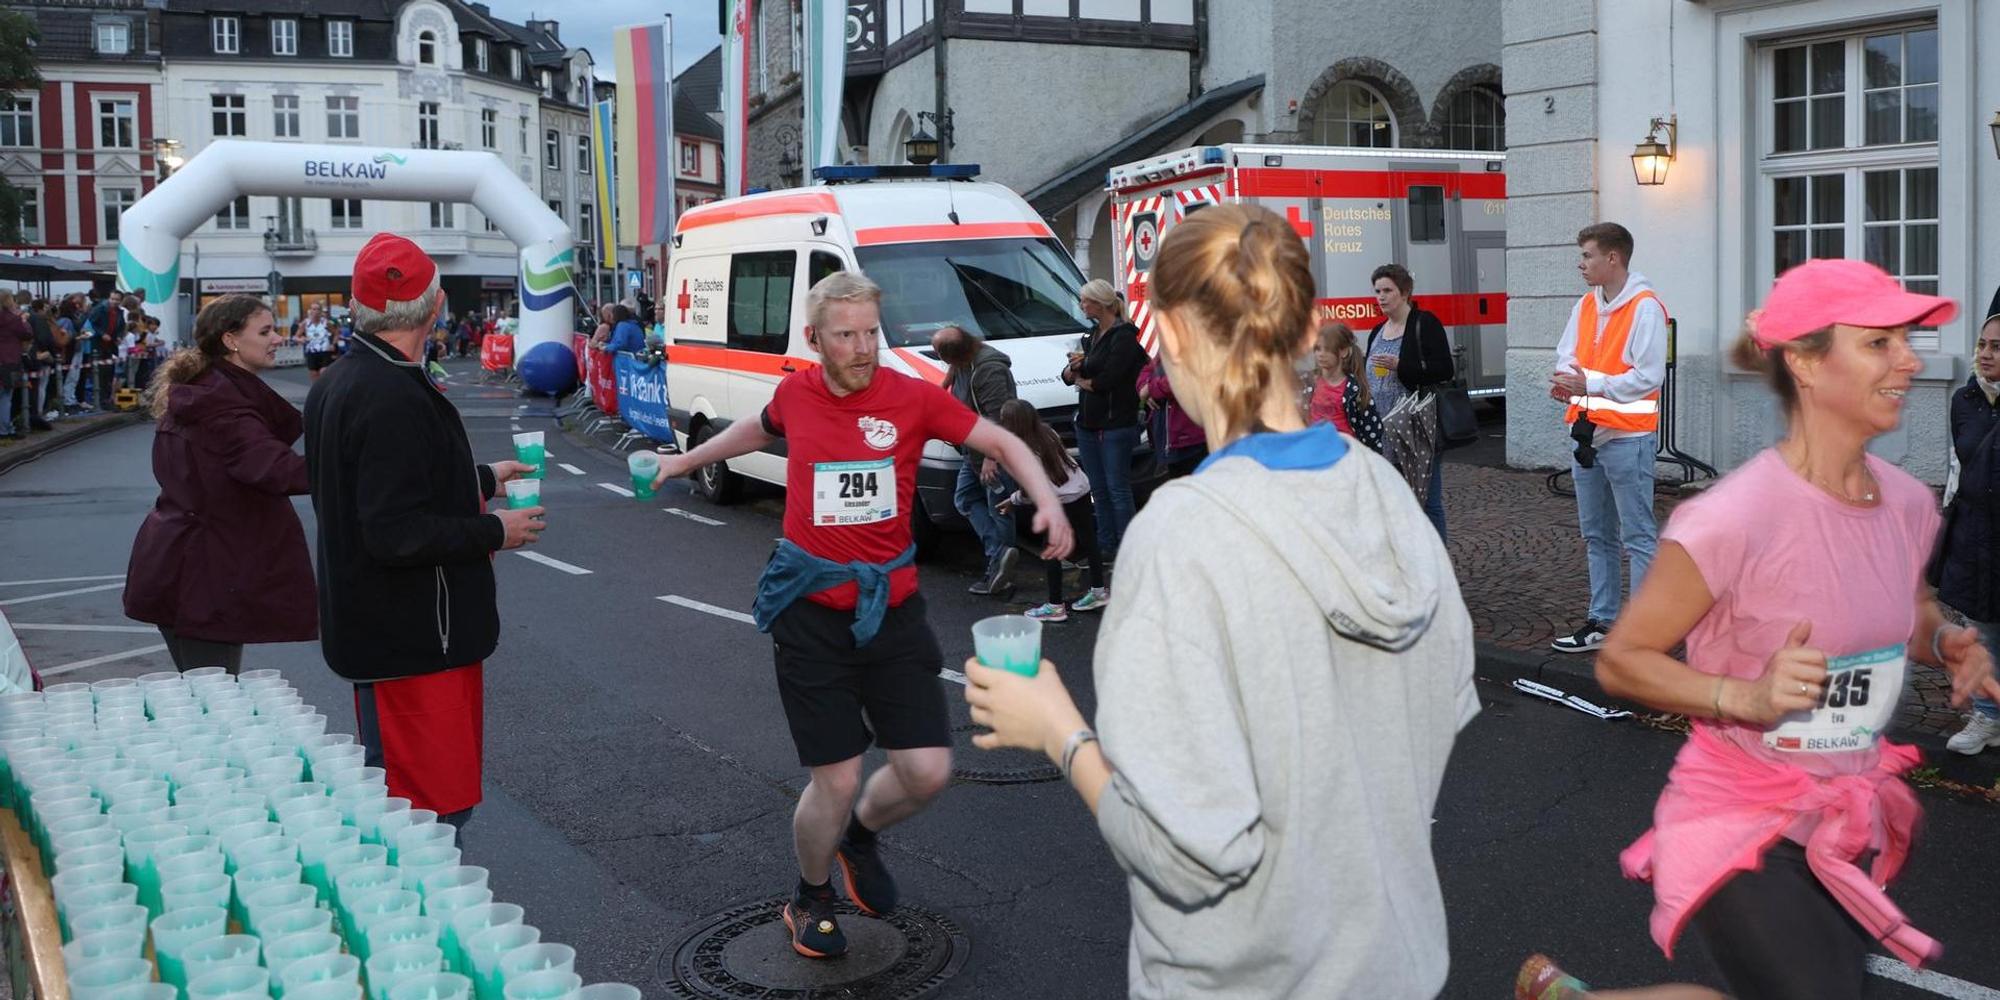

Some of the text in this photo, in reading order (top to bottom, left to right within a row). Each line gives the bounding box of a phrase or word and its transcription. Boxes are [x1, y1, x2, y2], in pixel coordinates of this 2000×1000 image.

[1544, 96, 1555, 114] 2
[305, 160, 386, 179] BELKAW
[1322, 206, 1391, 220] Deutsches
[1324, 223, 1362, 236] Rotes
[1325, 240, 1362, 253] Kreuz
[694, 278, 724, 291] Deutsches
[839, 472, 878, 498] 294
[839, 515, 872, 523] BELKAW
[1831, 713, 1845, 724] Eva
[1807, 737, 1859, 749] BELKAW
